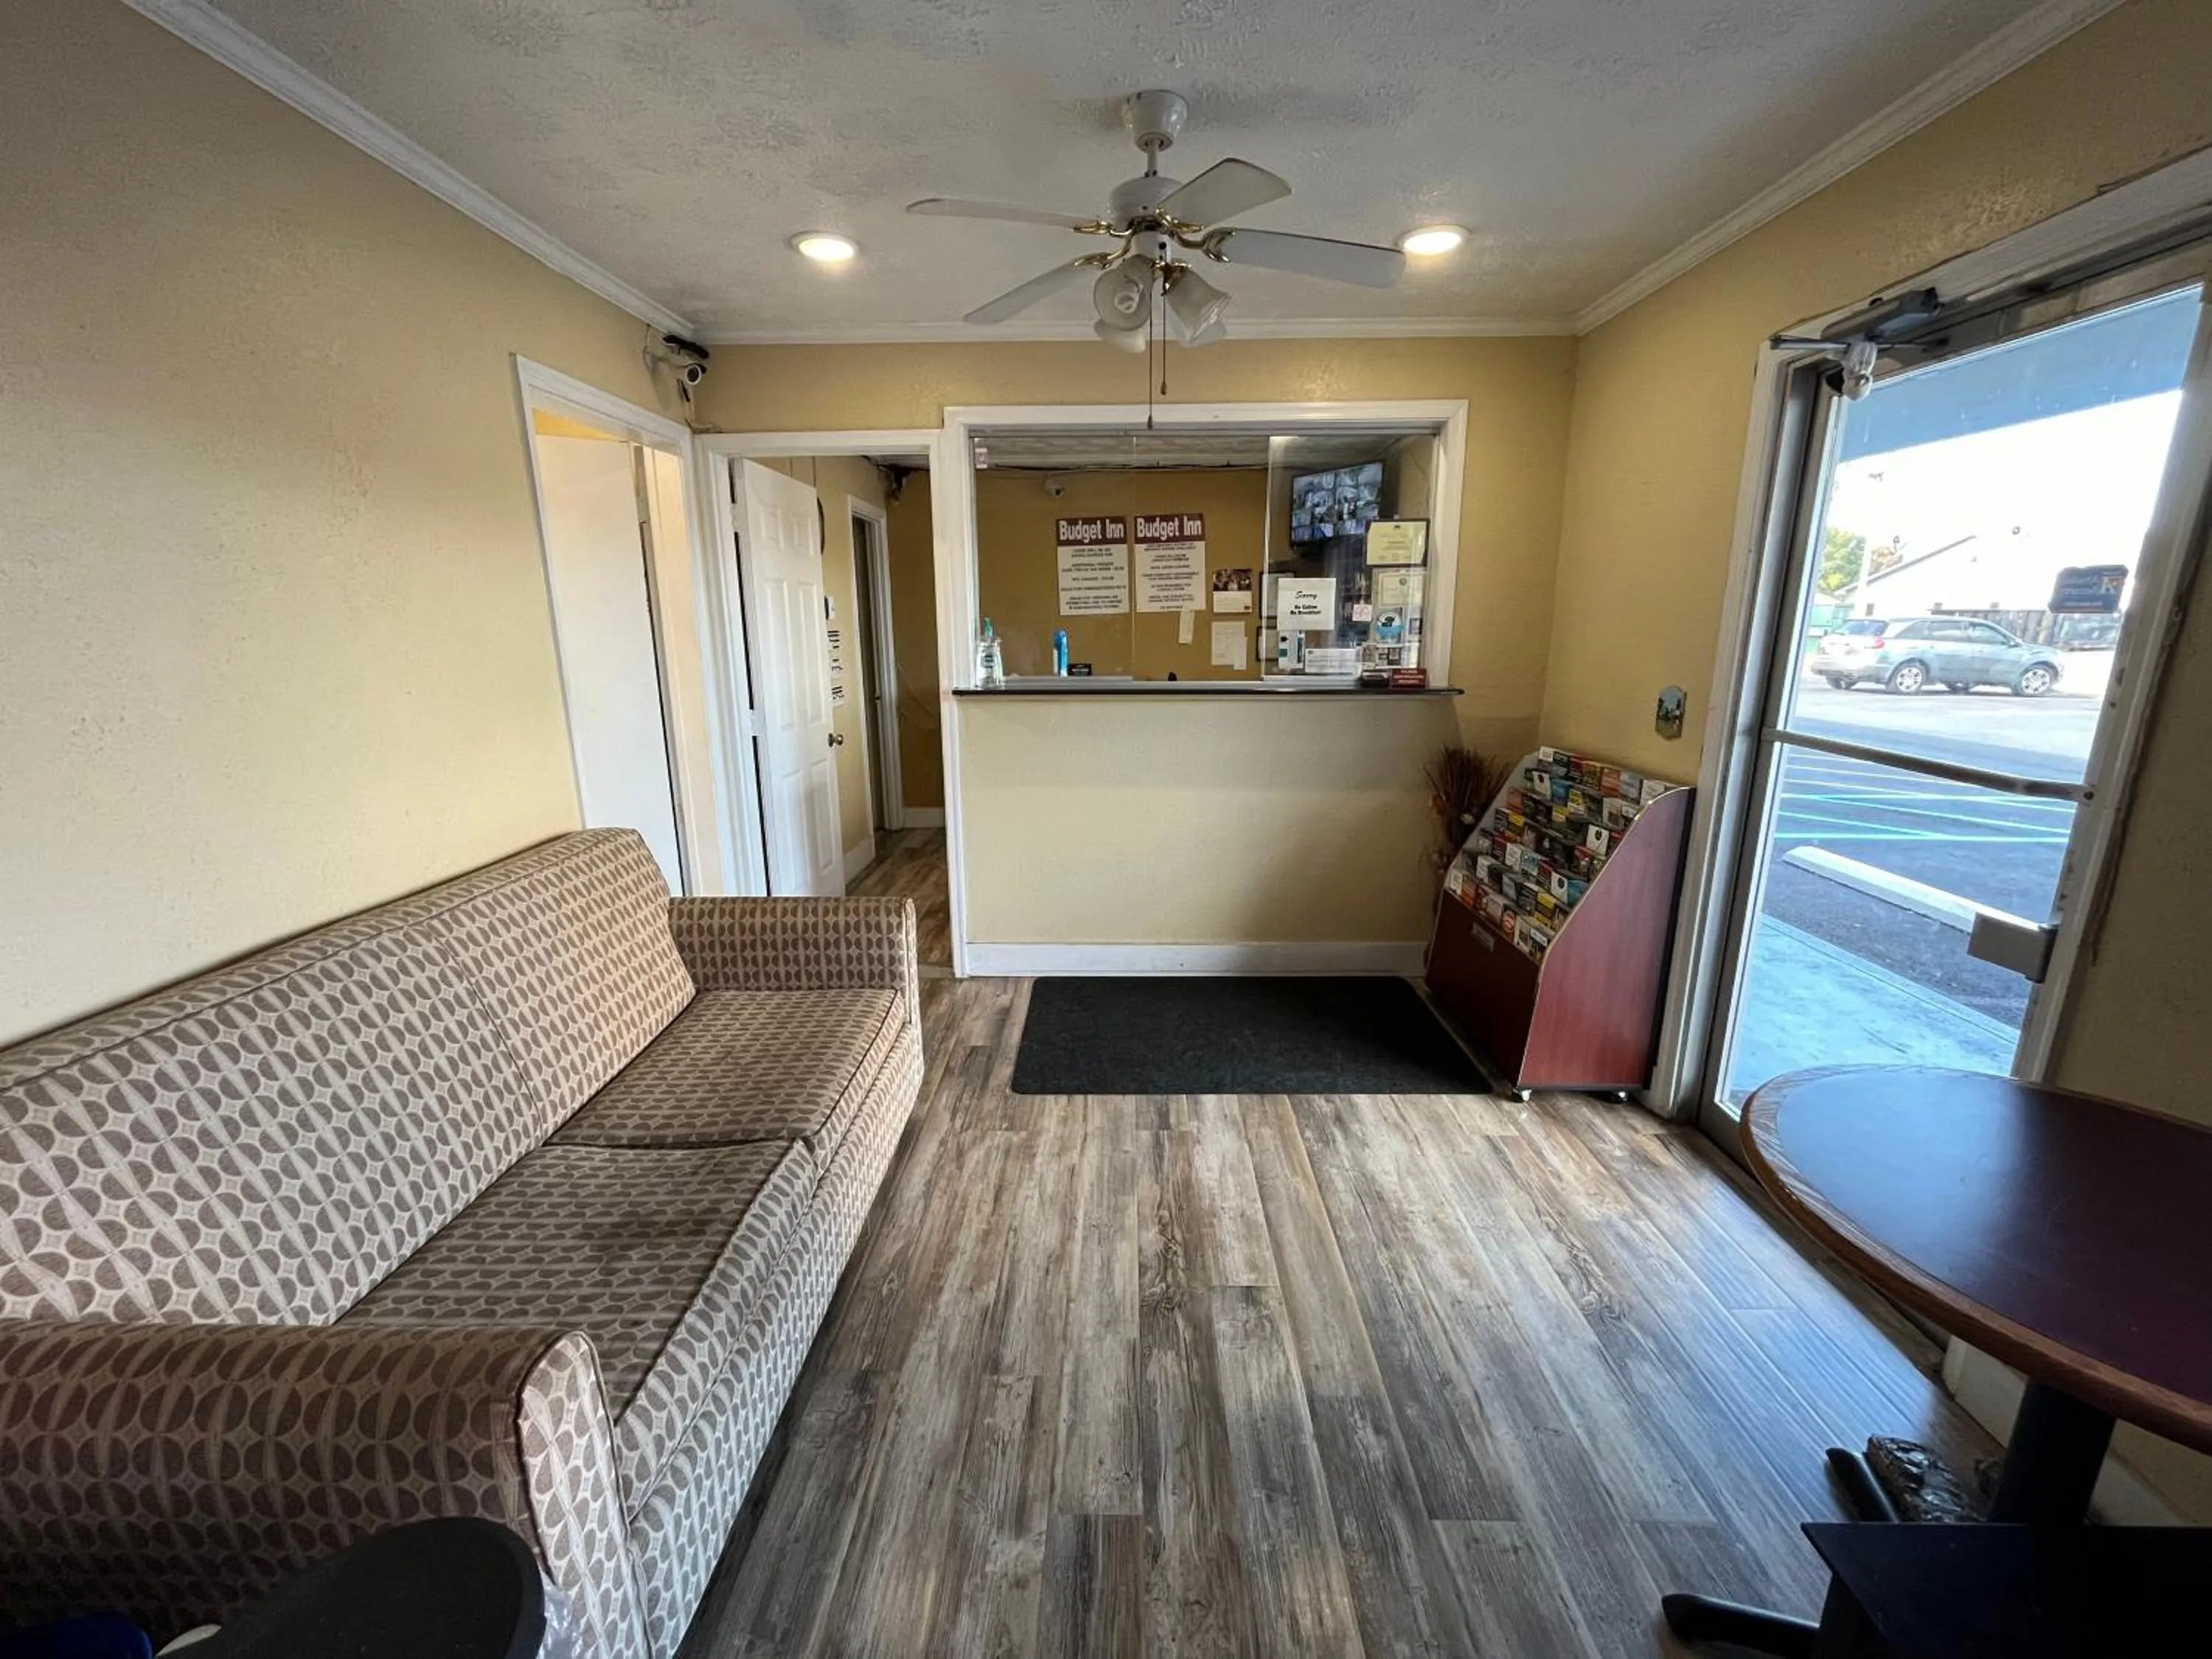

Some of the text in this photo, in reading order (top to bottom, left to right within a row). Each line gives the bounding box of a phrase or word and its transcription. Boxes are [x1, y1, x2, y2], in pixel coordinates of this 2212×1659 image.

[1059, 518, 1124, 543] Budget Inn
[1136, 515, 1202, 541] Budget Inn
